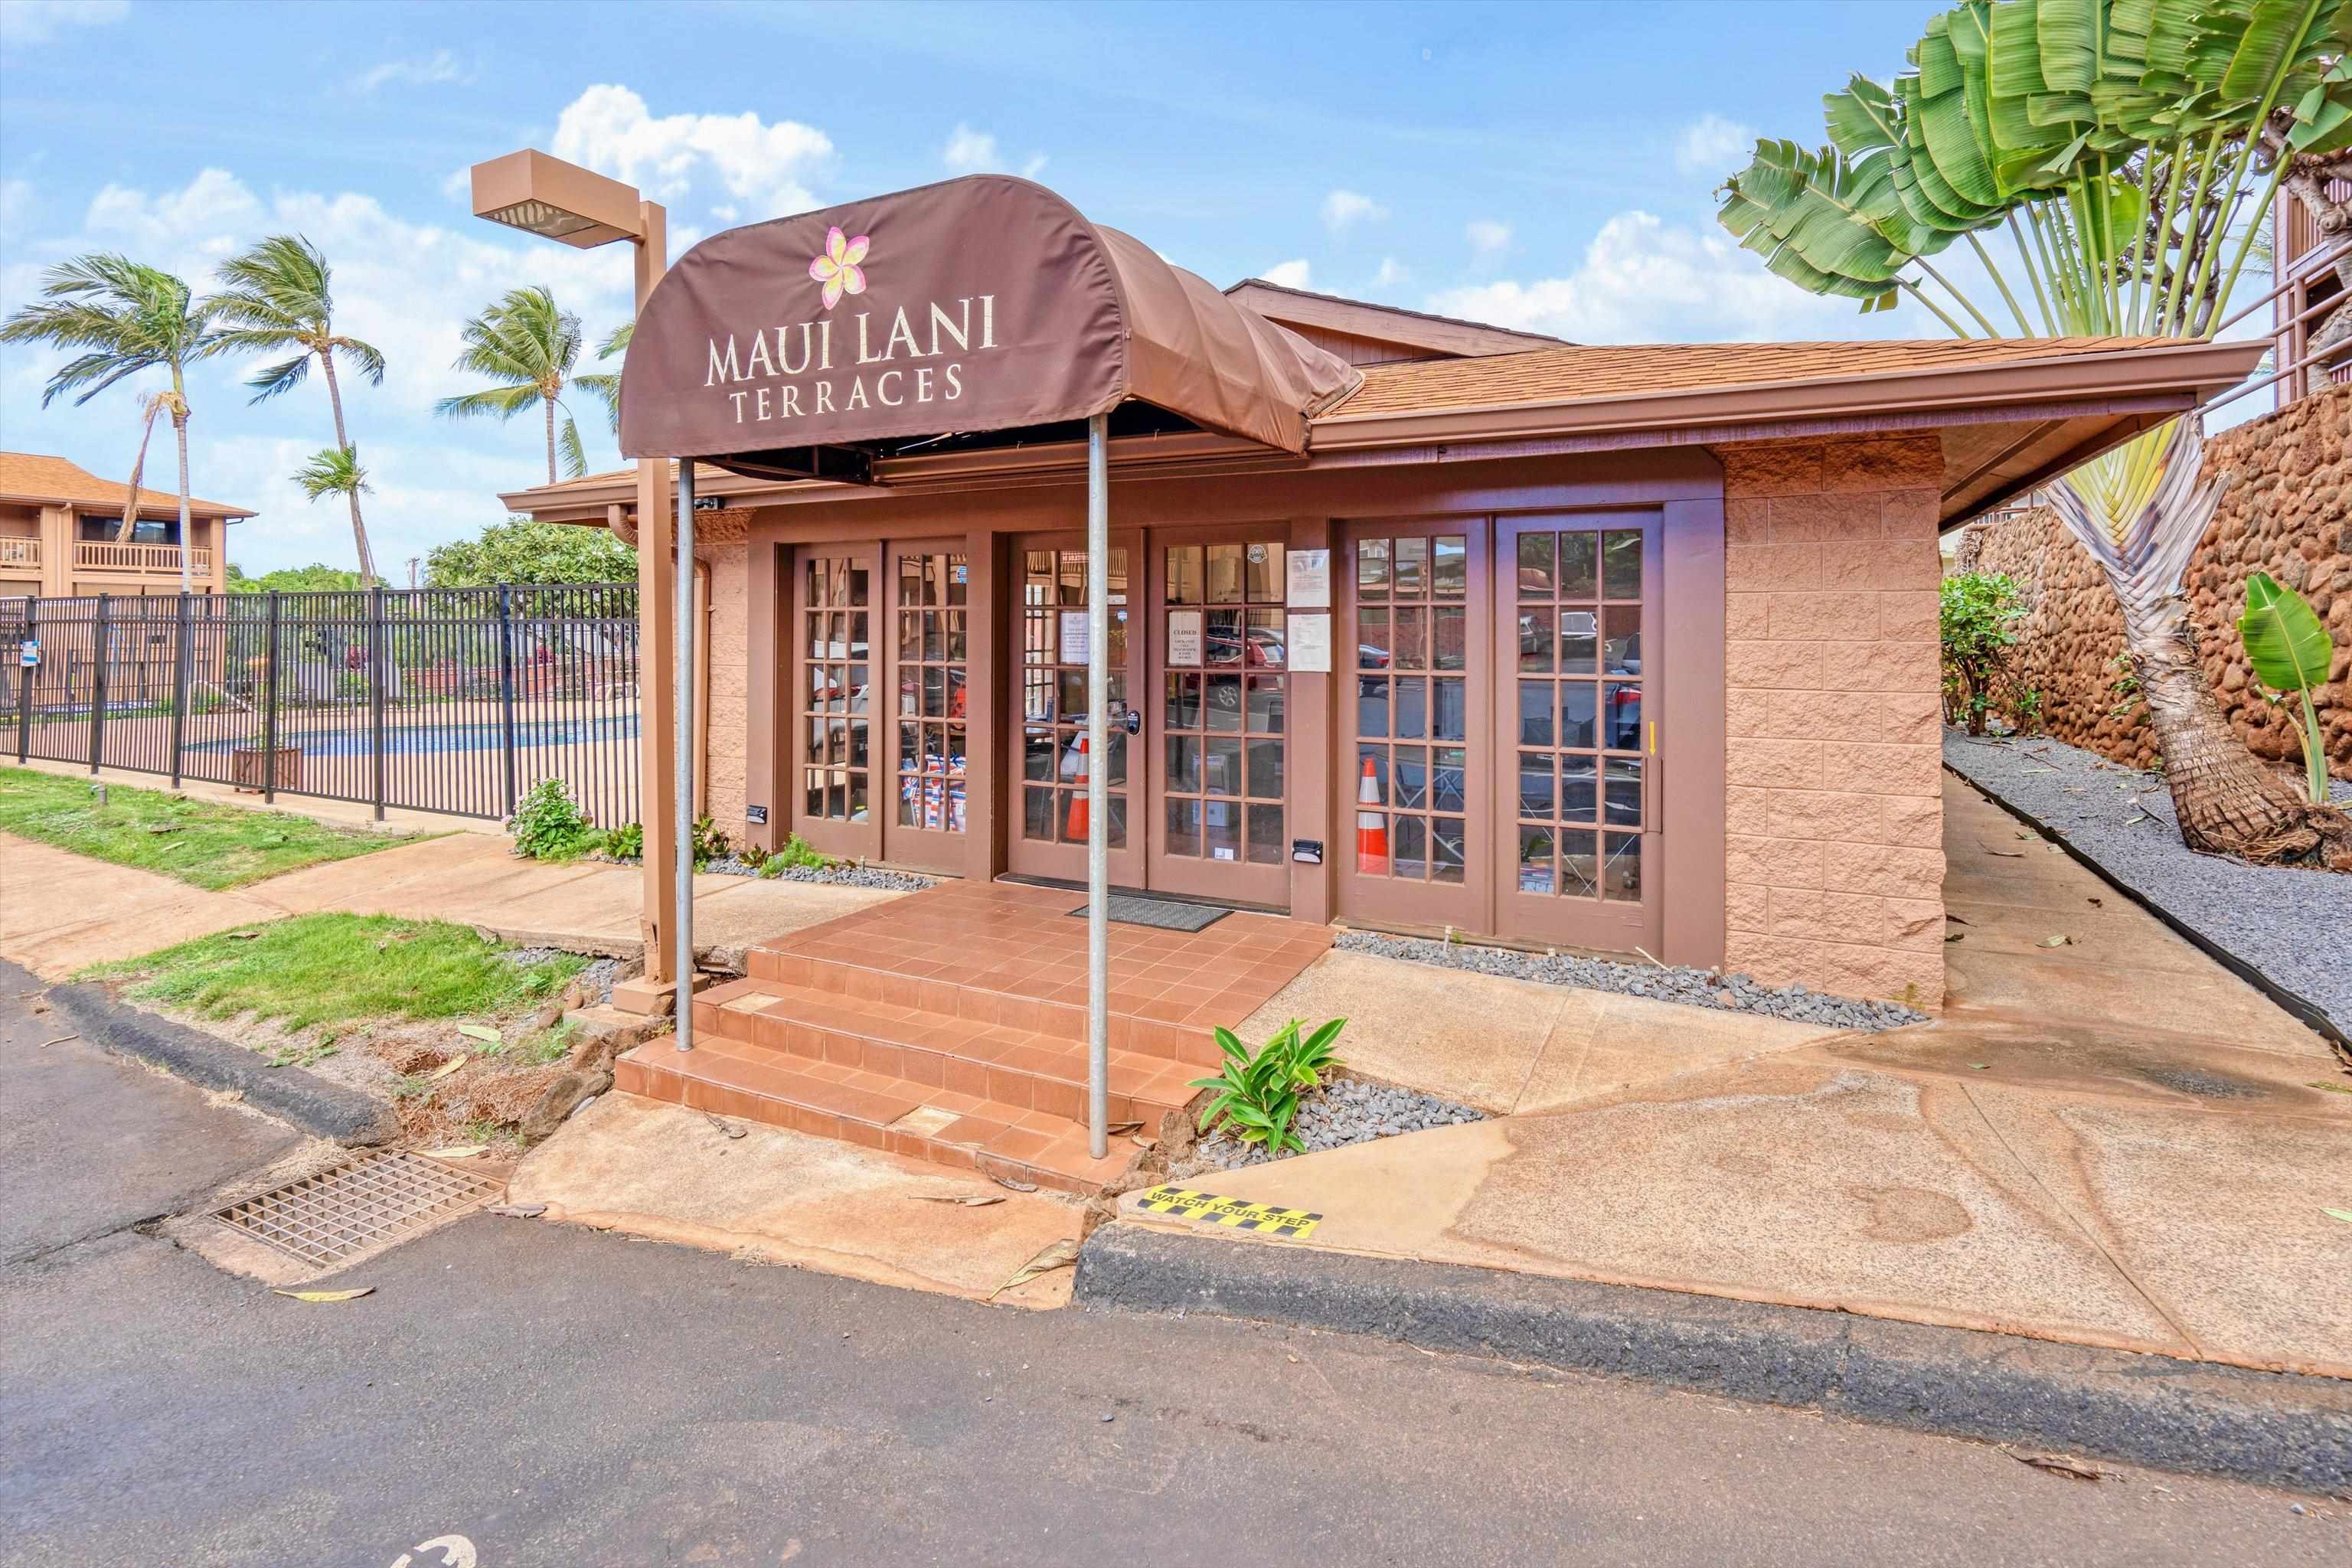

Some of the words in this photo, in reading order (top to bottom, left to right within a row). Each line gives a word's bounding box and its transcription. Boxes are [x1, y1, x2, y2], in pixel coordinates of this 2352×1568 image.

[704, 319, 834, 387] MAUI
[854, 295, 998, 364] LANI
[729, 364, 962, 423] TERRACES
[1151, 1192, 1208, 1209] WATCH
[1213, 1204, 1259, 1219] YOUR
[1263, 1214, 1310, 1227] STEP
